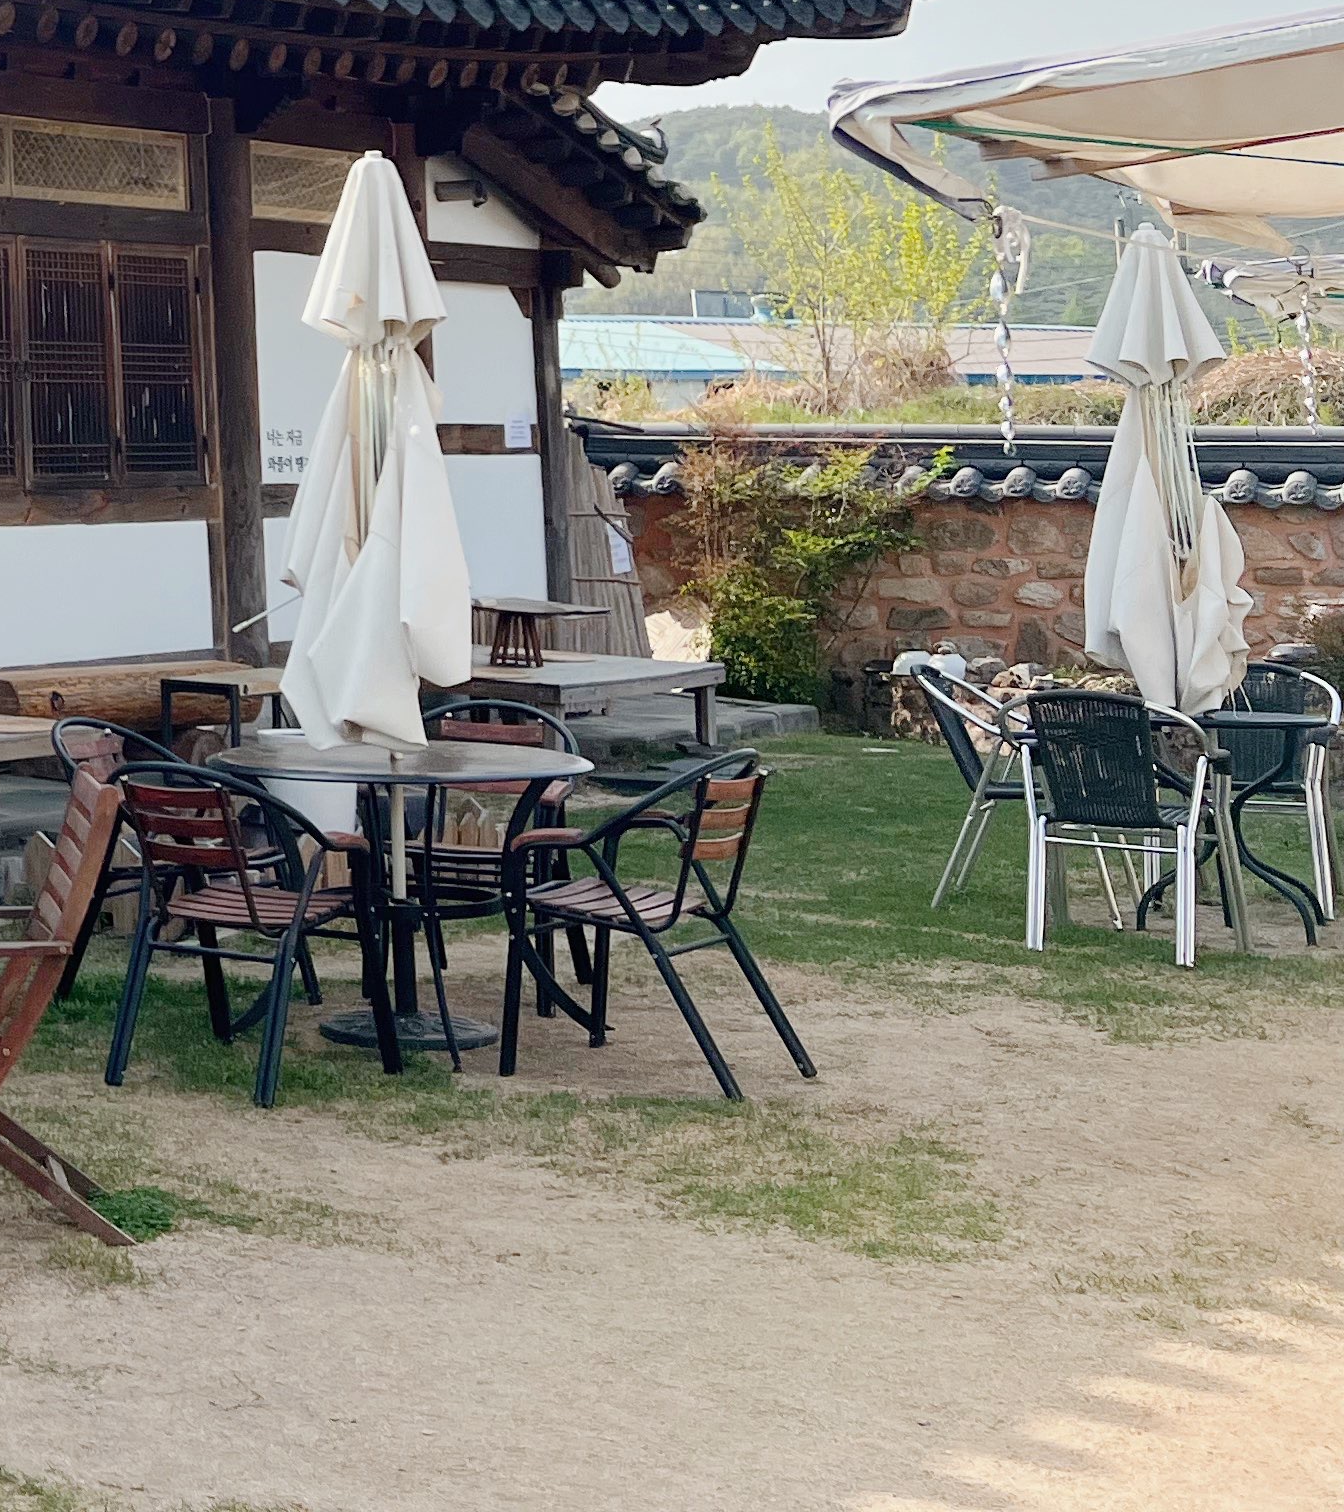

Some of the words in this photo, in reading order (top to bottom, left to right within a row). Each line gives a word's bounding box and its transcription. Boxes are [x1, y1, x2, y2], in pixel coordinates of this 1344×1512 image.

[266, 428, 284, 447] 너는
[286, 428, 303, 447] 지금
[267, 455, 293, 473] 와플이
